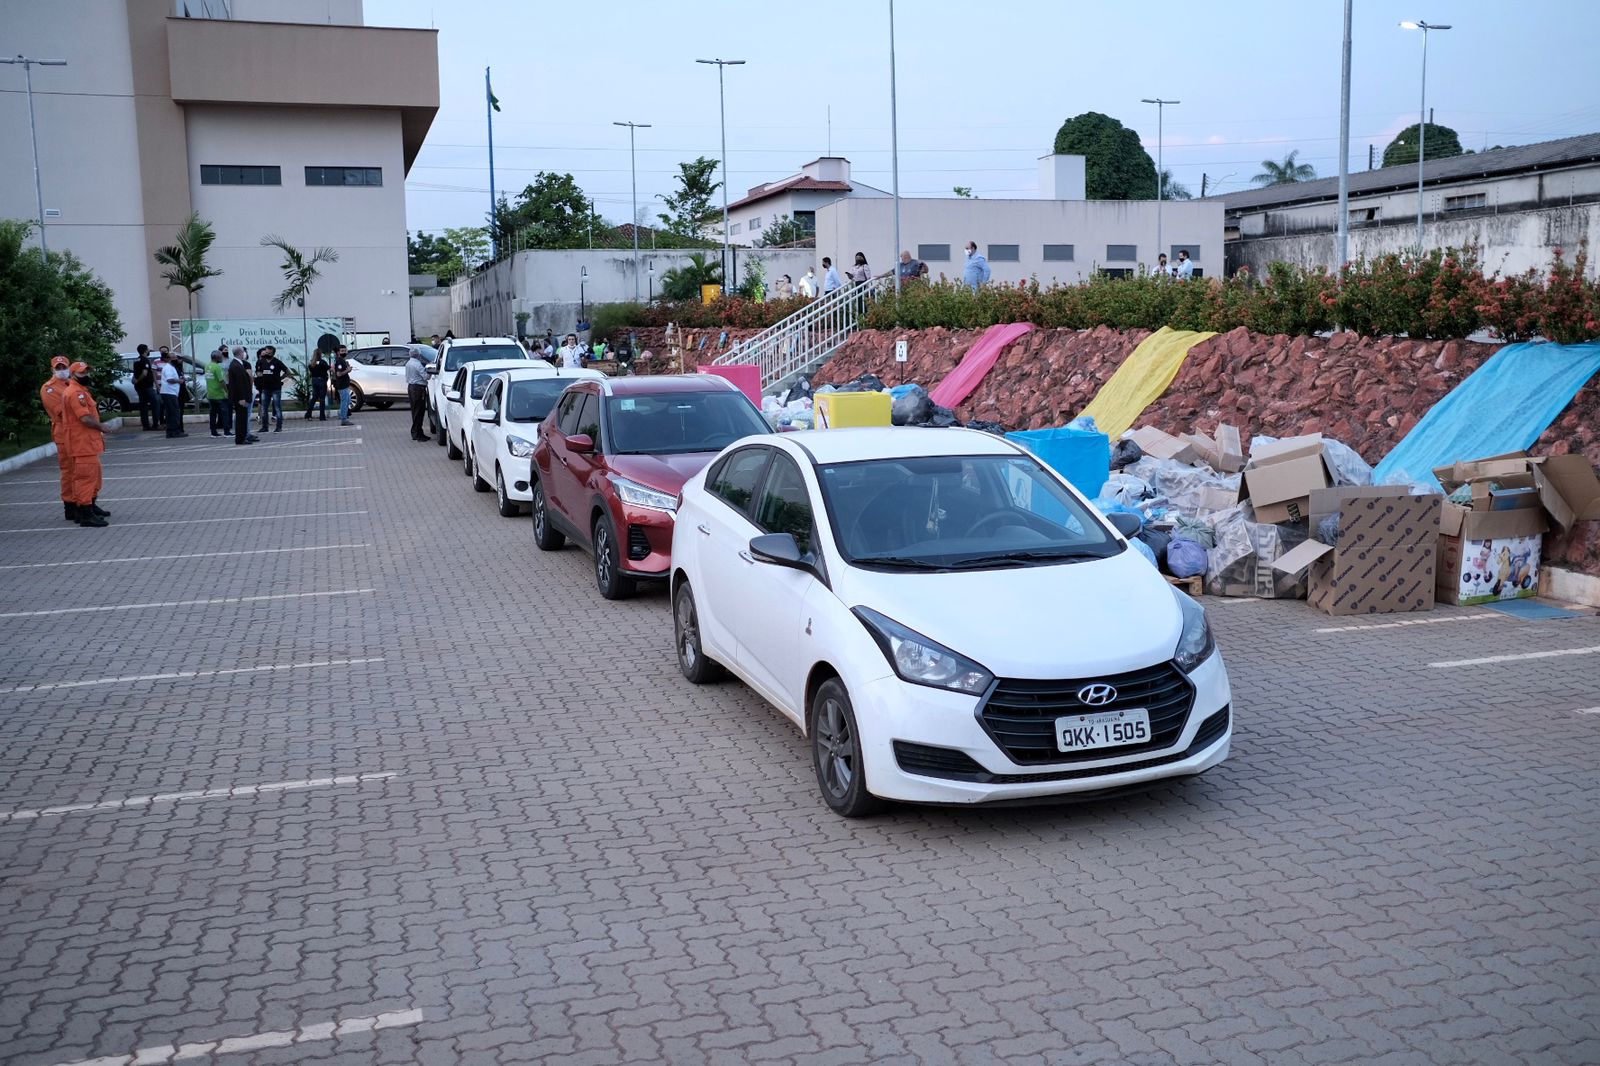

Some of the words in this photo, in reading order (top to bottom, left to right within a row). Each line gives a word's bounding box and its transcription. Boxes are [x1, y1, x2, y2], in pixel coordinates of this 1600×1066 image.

[239, 327, 257, 336] Drive
[260, 327, 275, 336] Thru
[277, 328, 287, 336] da
[221, 337, 243, 346] Coleta
[245, 336, 272, 345] Seletiva
